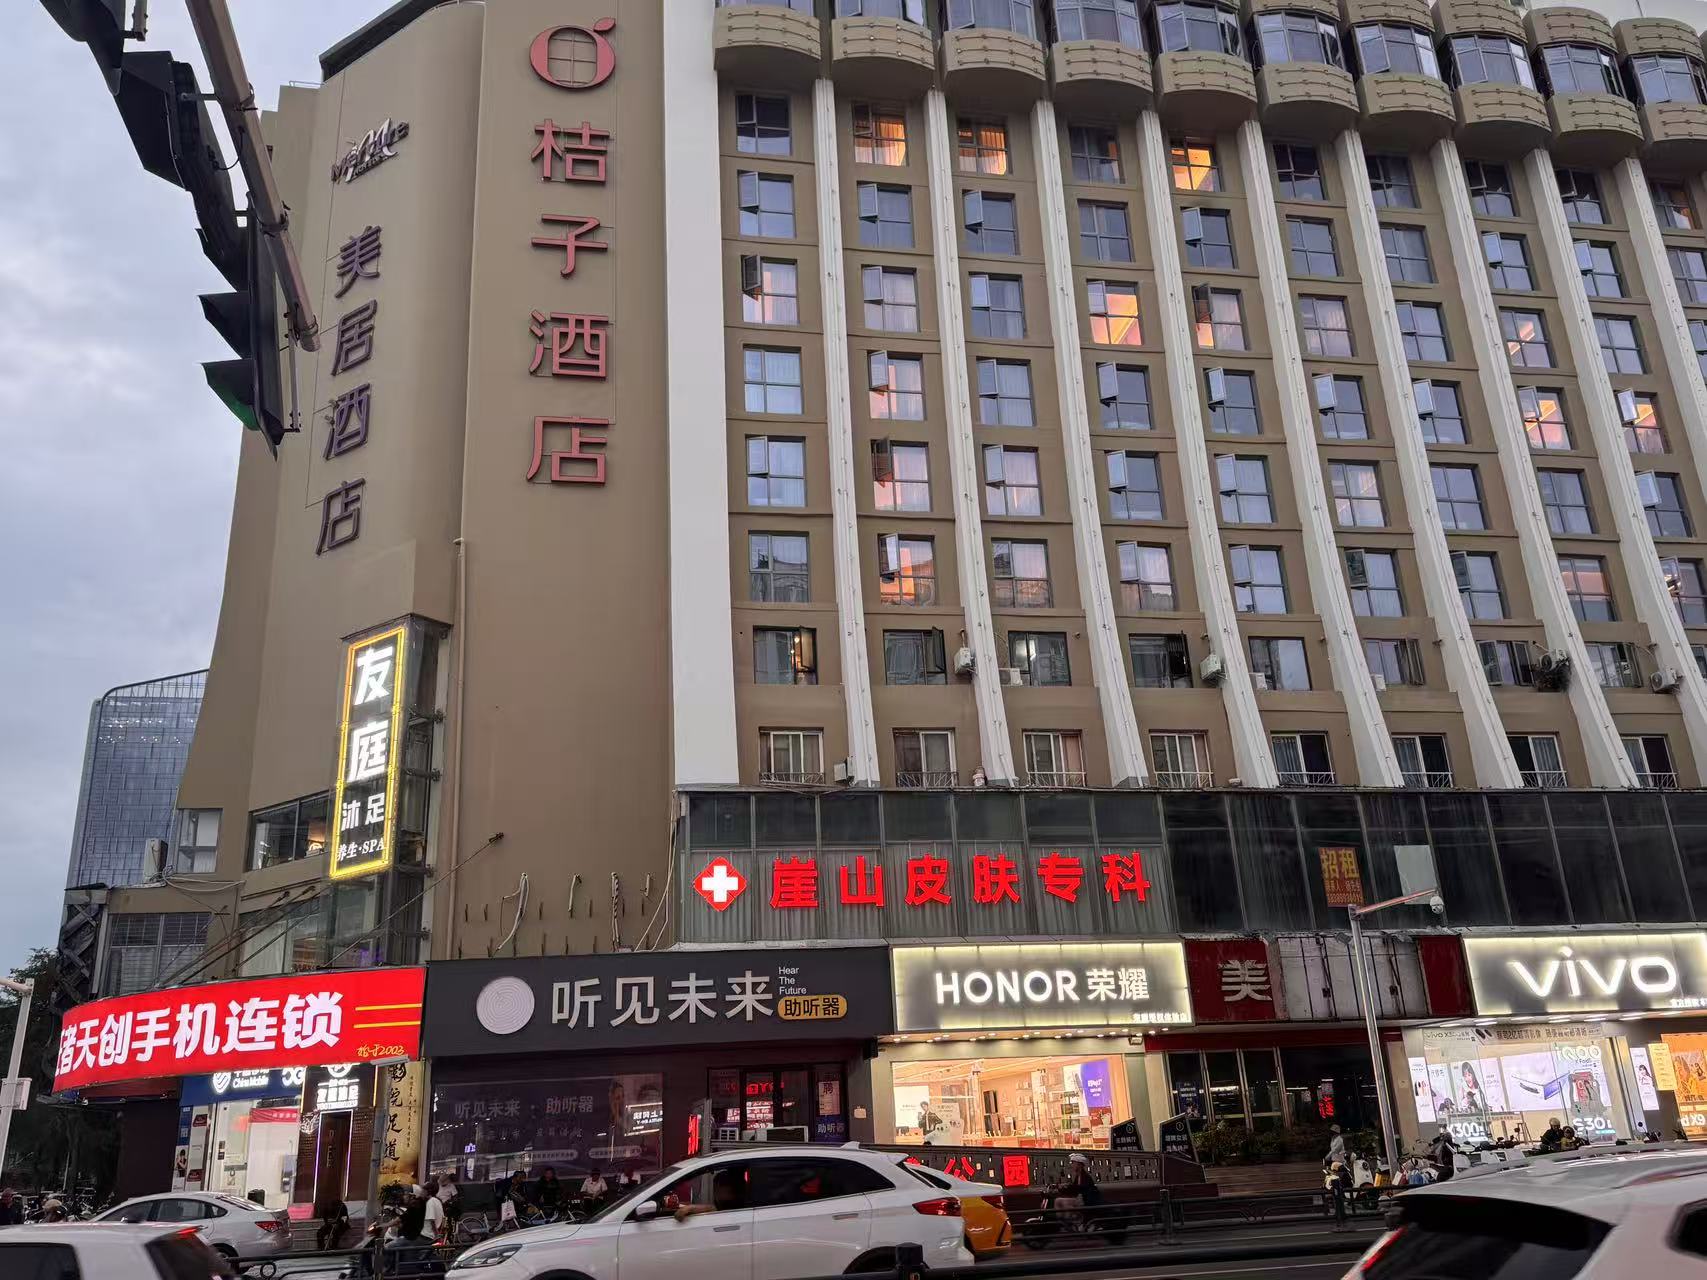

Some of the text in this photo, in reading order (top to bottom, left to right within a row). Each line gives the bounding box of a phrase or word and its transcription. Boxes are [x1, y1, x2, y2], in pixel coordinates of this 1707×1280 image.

[526, 118, 610, 485] 桔子酒店
[316, 225, 382, 555] 美居酒店
[347, 646, 394, 782] 友庭
[341, 792, 385, 831] 沐足
[768, 851, 1152, 909] 崖山皮肤专科
[1320, 848, 1360, 879] 招租
[778, 966, 800, 975] Hear
[779, 976, 796, 985] The
[935, 967, 1150, 1004] HONOR 荣耀
[1217, 959, 1272, 1002] 美
[1507, 946, 1678, 998] vivo
[550, 970, 774, 1029] 听见未来
[779, 986, 807, 995] Future
[784, 997, 840, 1017] 助听器
[454, 1096, 593, 1118] 听见未来 助听器
